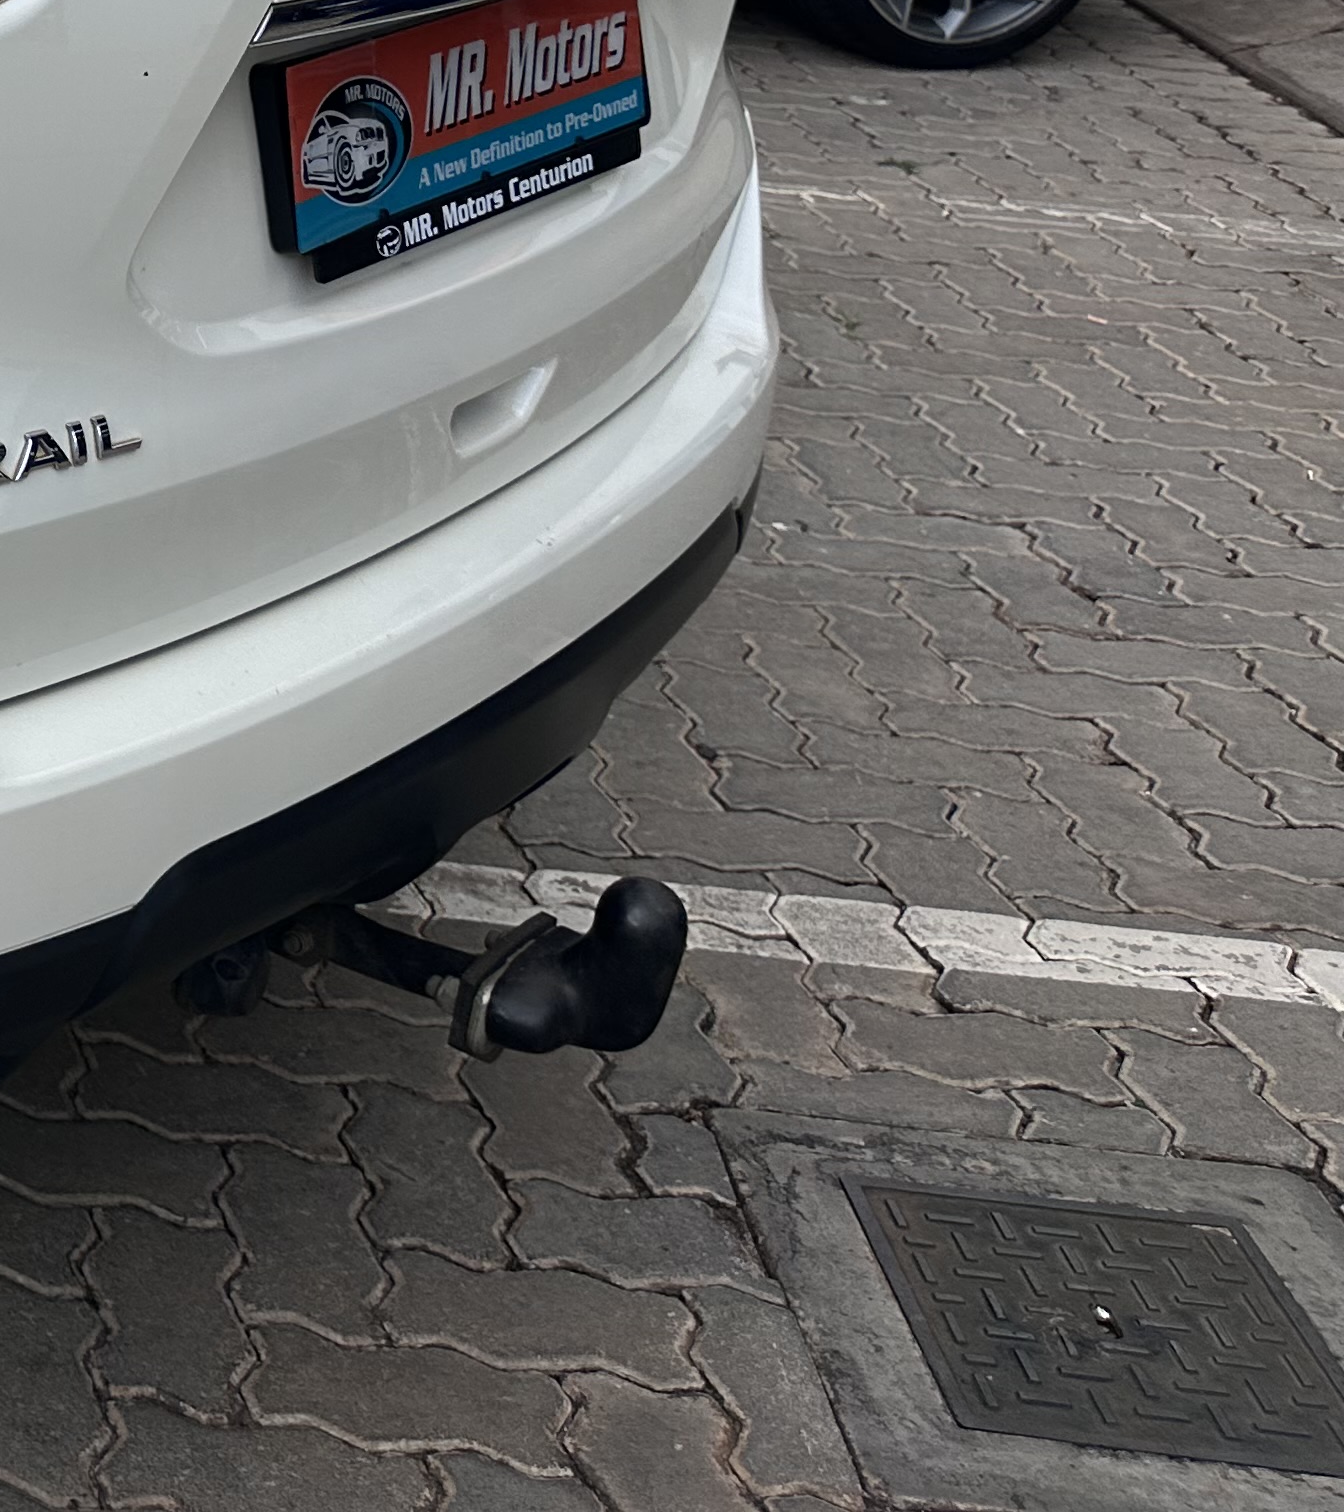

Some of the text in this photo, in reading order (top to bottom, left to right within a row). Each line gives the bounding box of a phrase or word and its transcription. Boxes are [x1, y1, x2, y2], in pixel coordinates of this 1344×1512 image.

[344, 83, 406, 122] MR. MOTORS
[423, 11, 626, 135] MR. Motors
[418, 89, 638, 189] A New Definition to Pre-Owned
[403, 152, 595, 247] MR. Motors Centurion
